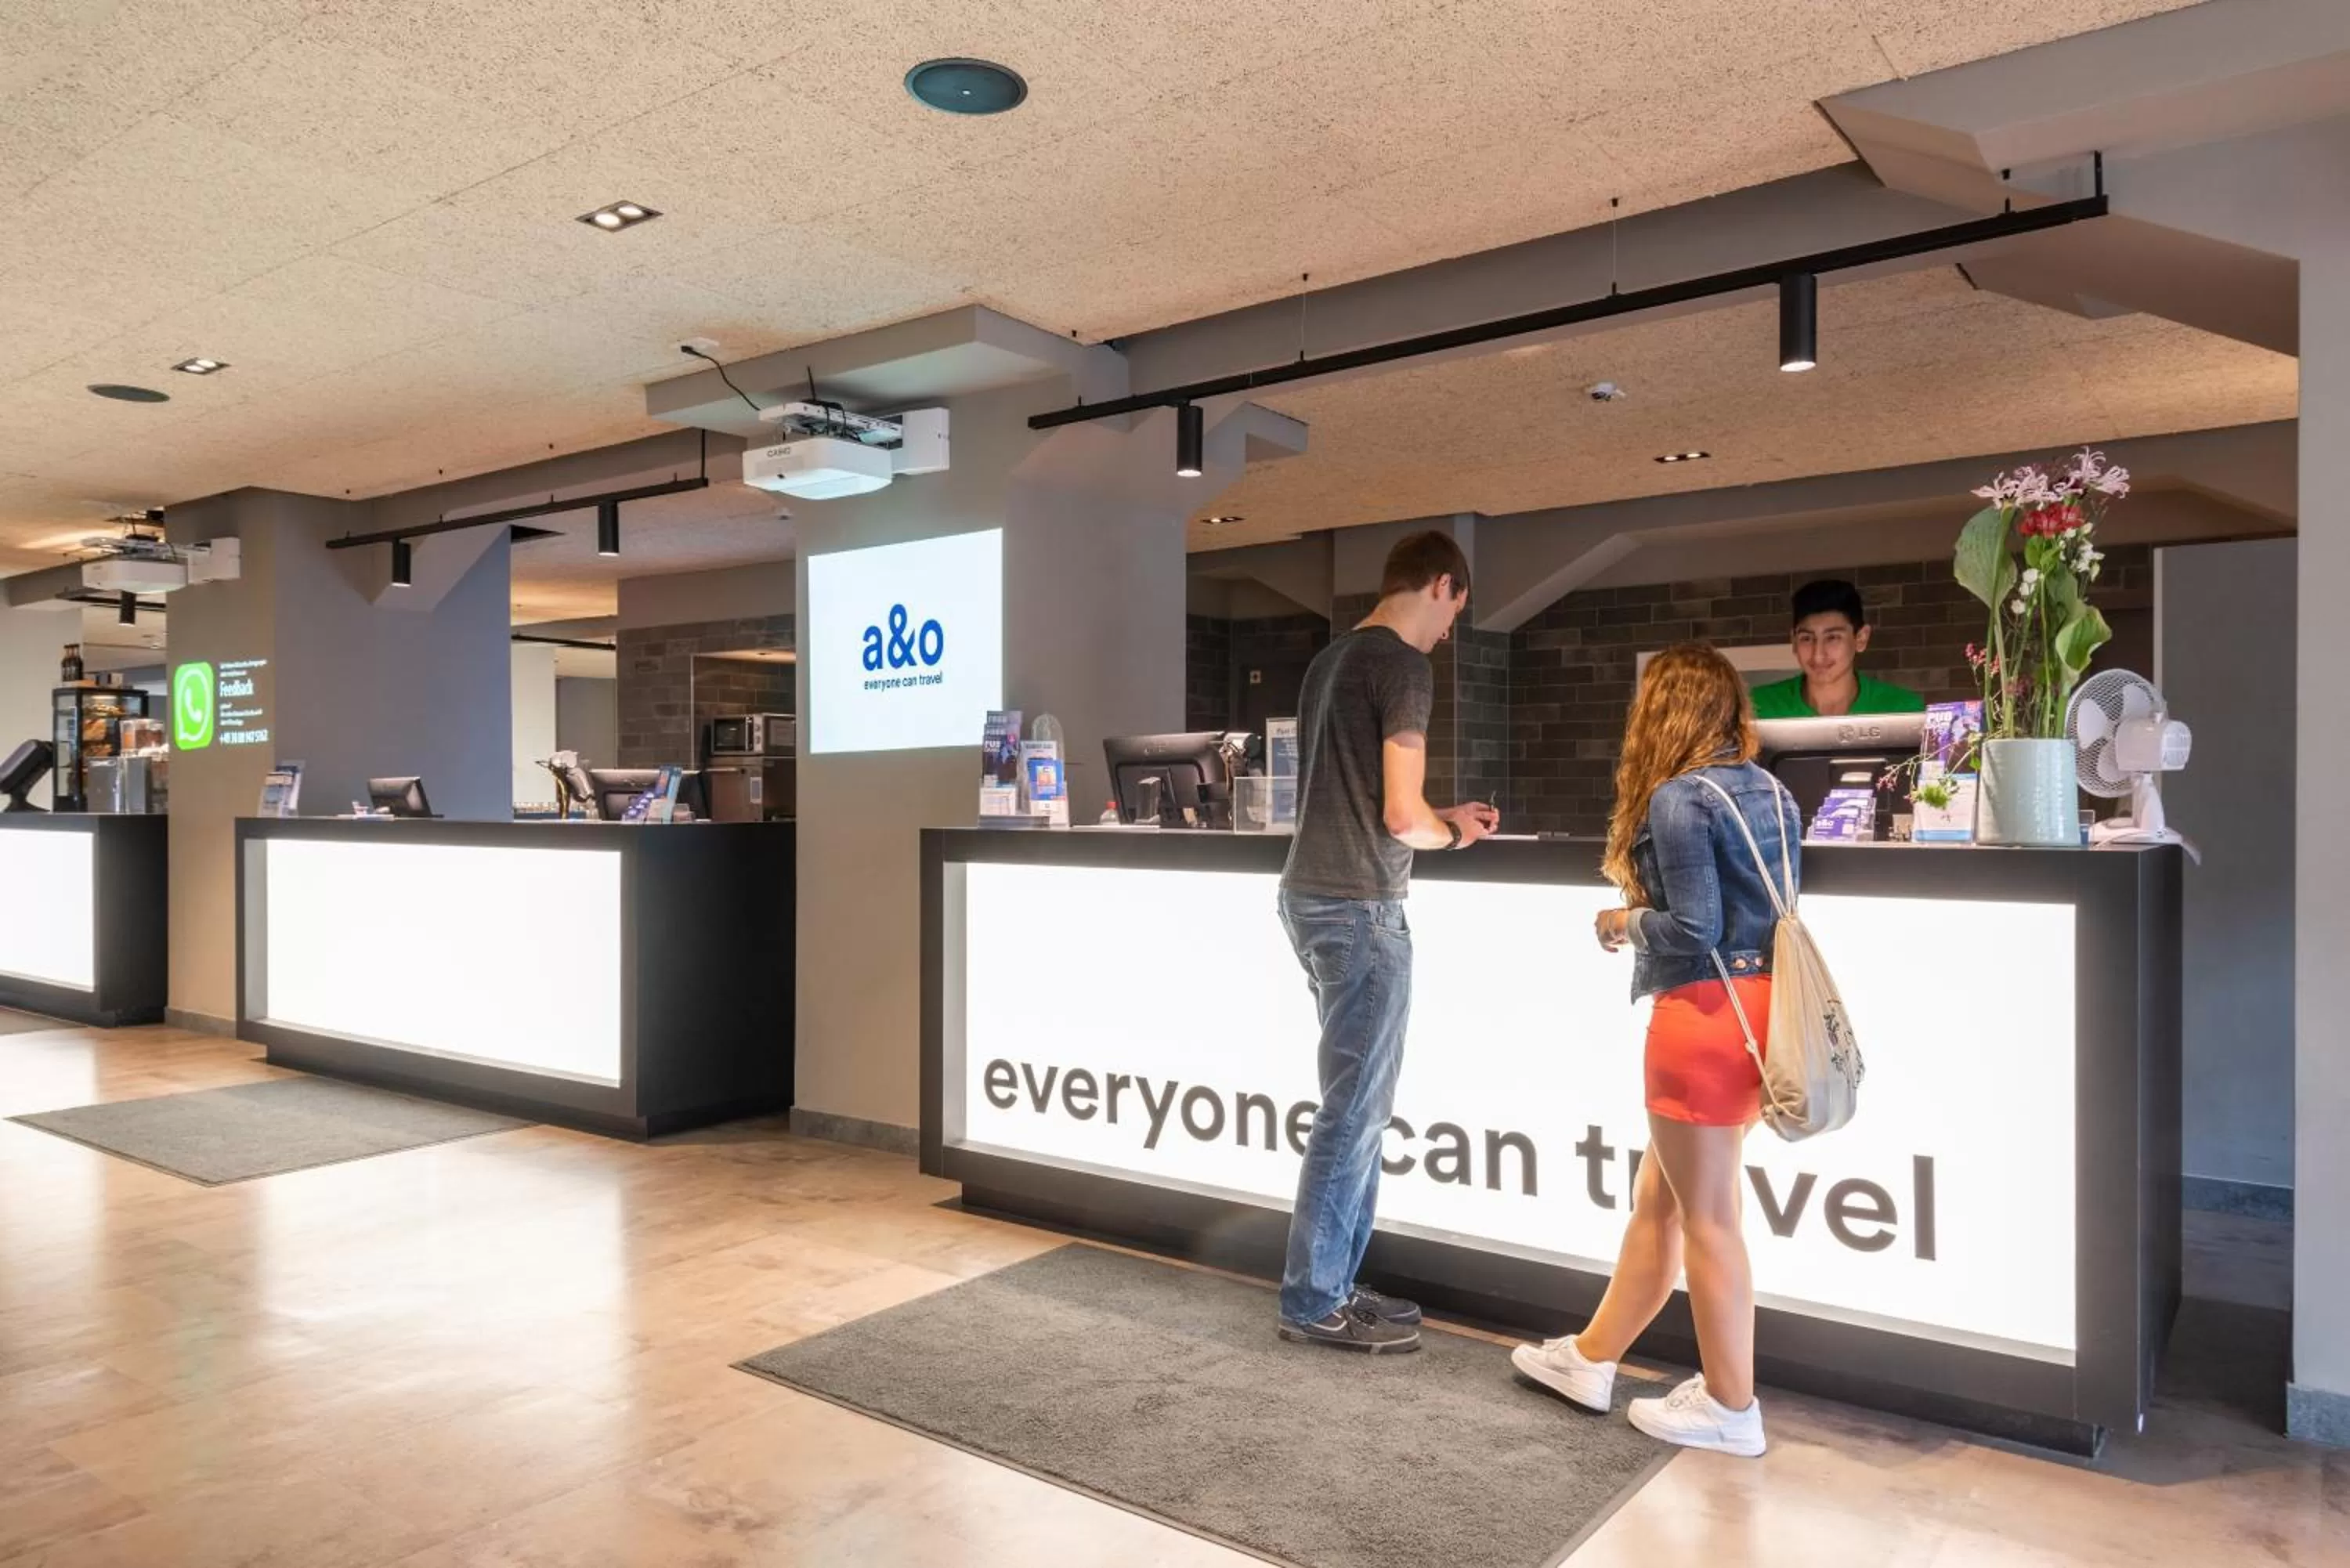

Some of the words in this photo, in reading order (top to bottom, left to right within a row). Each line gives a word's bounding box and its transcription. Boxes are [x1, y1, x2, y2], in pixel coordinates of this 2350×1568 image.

[862, 604, 944, 671] a&o
[220, 678, 254, 697] Feedback
[864, 678, 902, 692] everyone
[902, 676, 917, 687] can
[919, 670, 943, 685] travel
[1859, 726, 1881, 737] LG
[983, 1057, 1321, 1158] everyone
[1380, 1115, 1538, 1198] can
[1576, 1124, 1937, 1262] tvel
